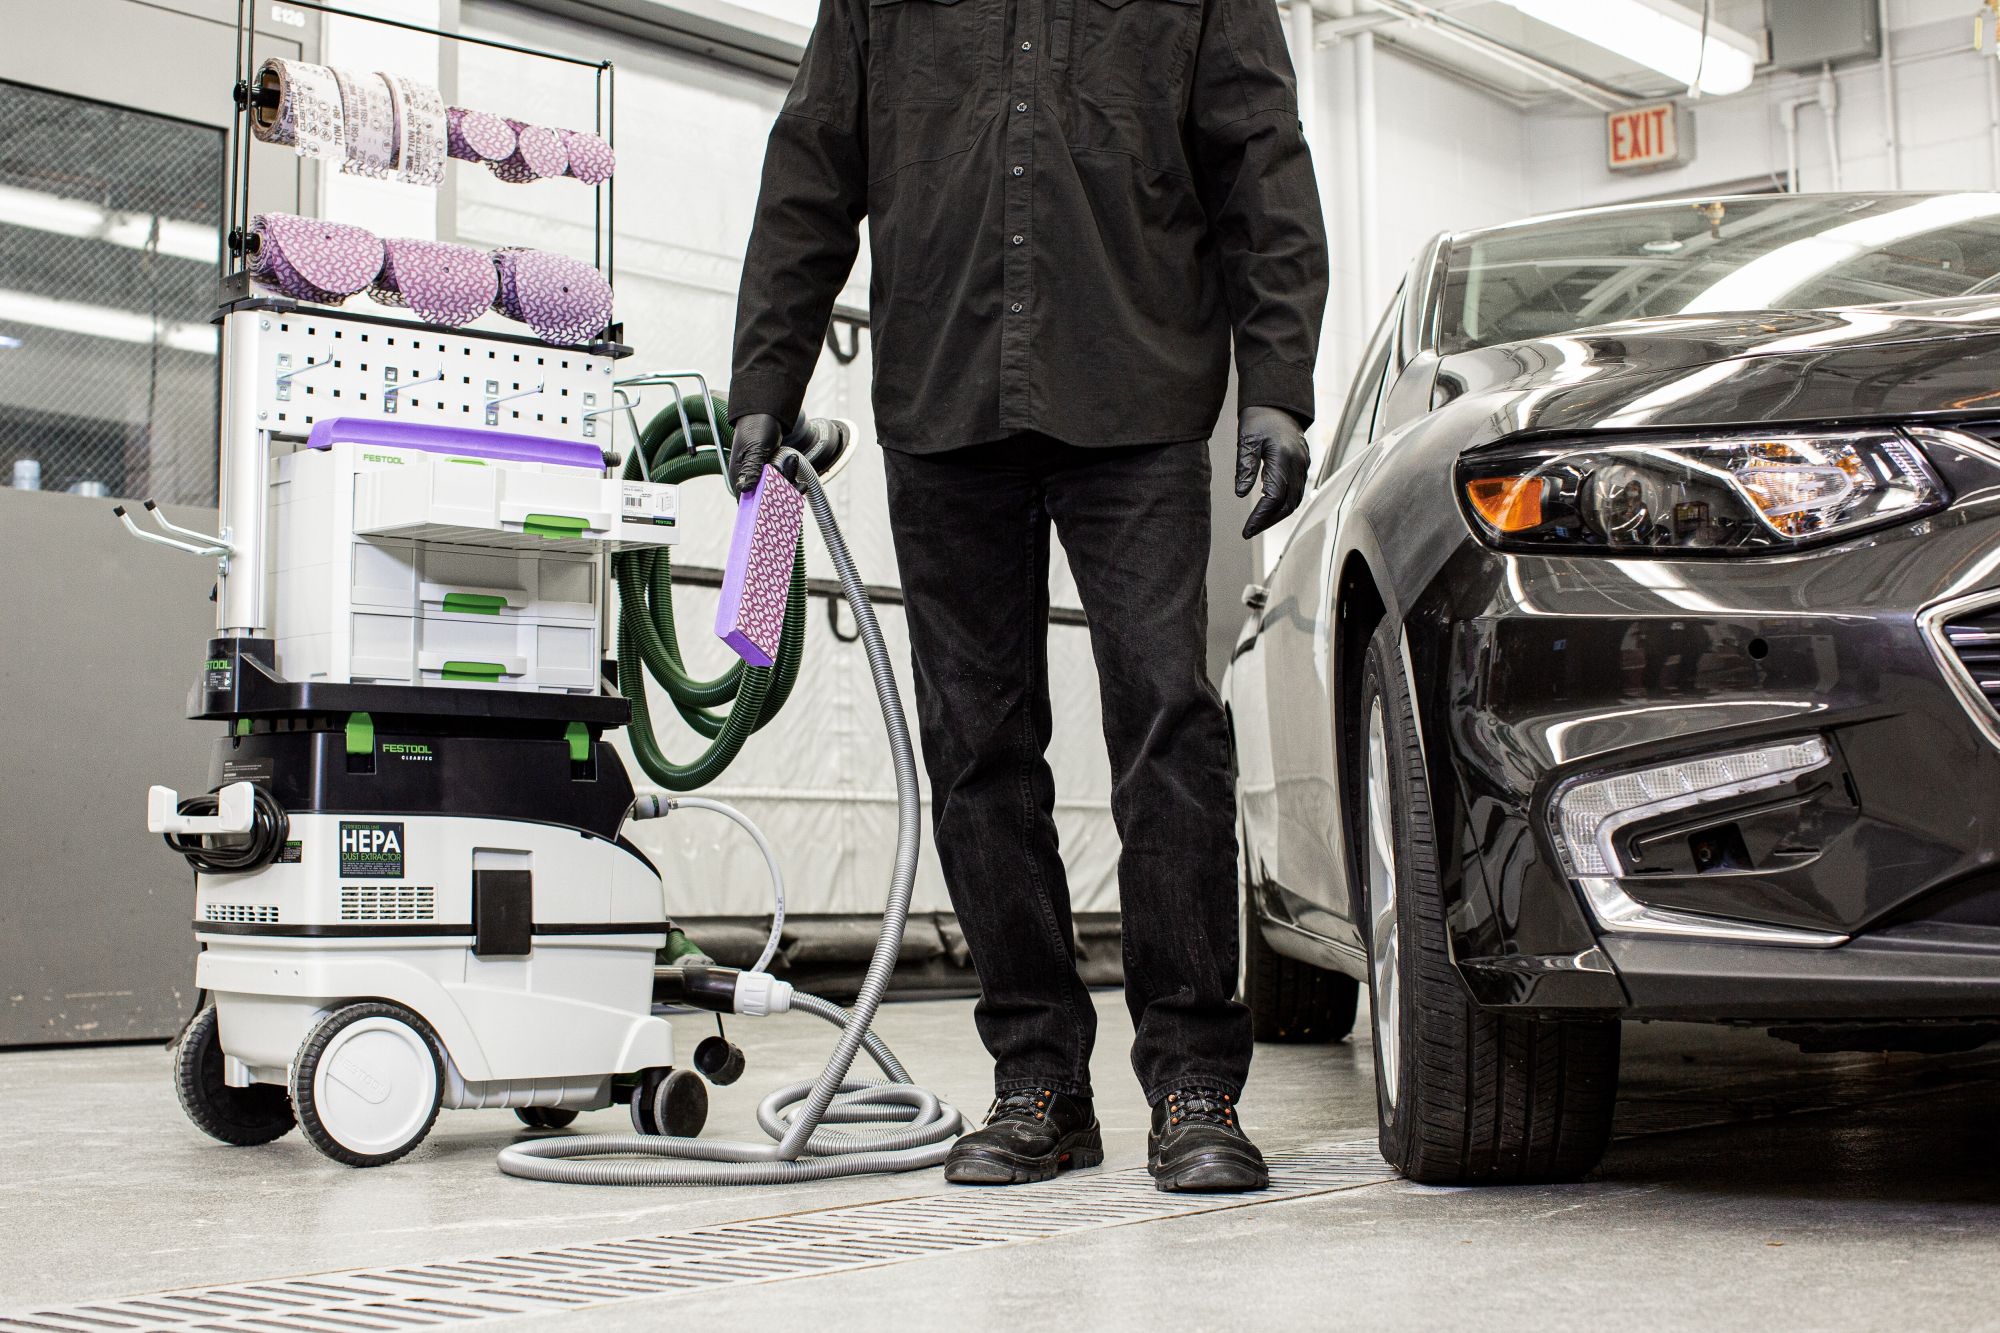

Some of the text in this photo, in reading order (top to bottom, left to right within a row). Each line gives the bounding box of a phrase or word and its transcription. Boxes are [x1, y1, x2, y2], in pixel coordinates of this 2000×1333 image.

[333, 123, 343, 147] 710W
[406, 129, 416, 153] 710W
[1611, 108, 1667, 161] EXIT
[363, 453, 405, 465] FESTOOL
[204, 660, 232, 670] STOOL
[382, 743, 433, 754] FESTOOL
[342, 829, 402, 853] HEPA
[342, 852, 402, 861] DUST EXTRACTOR
